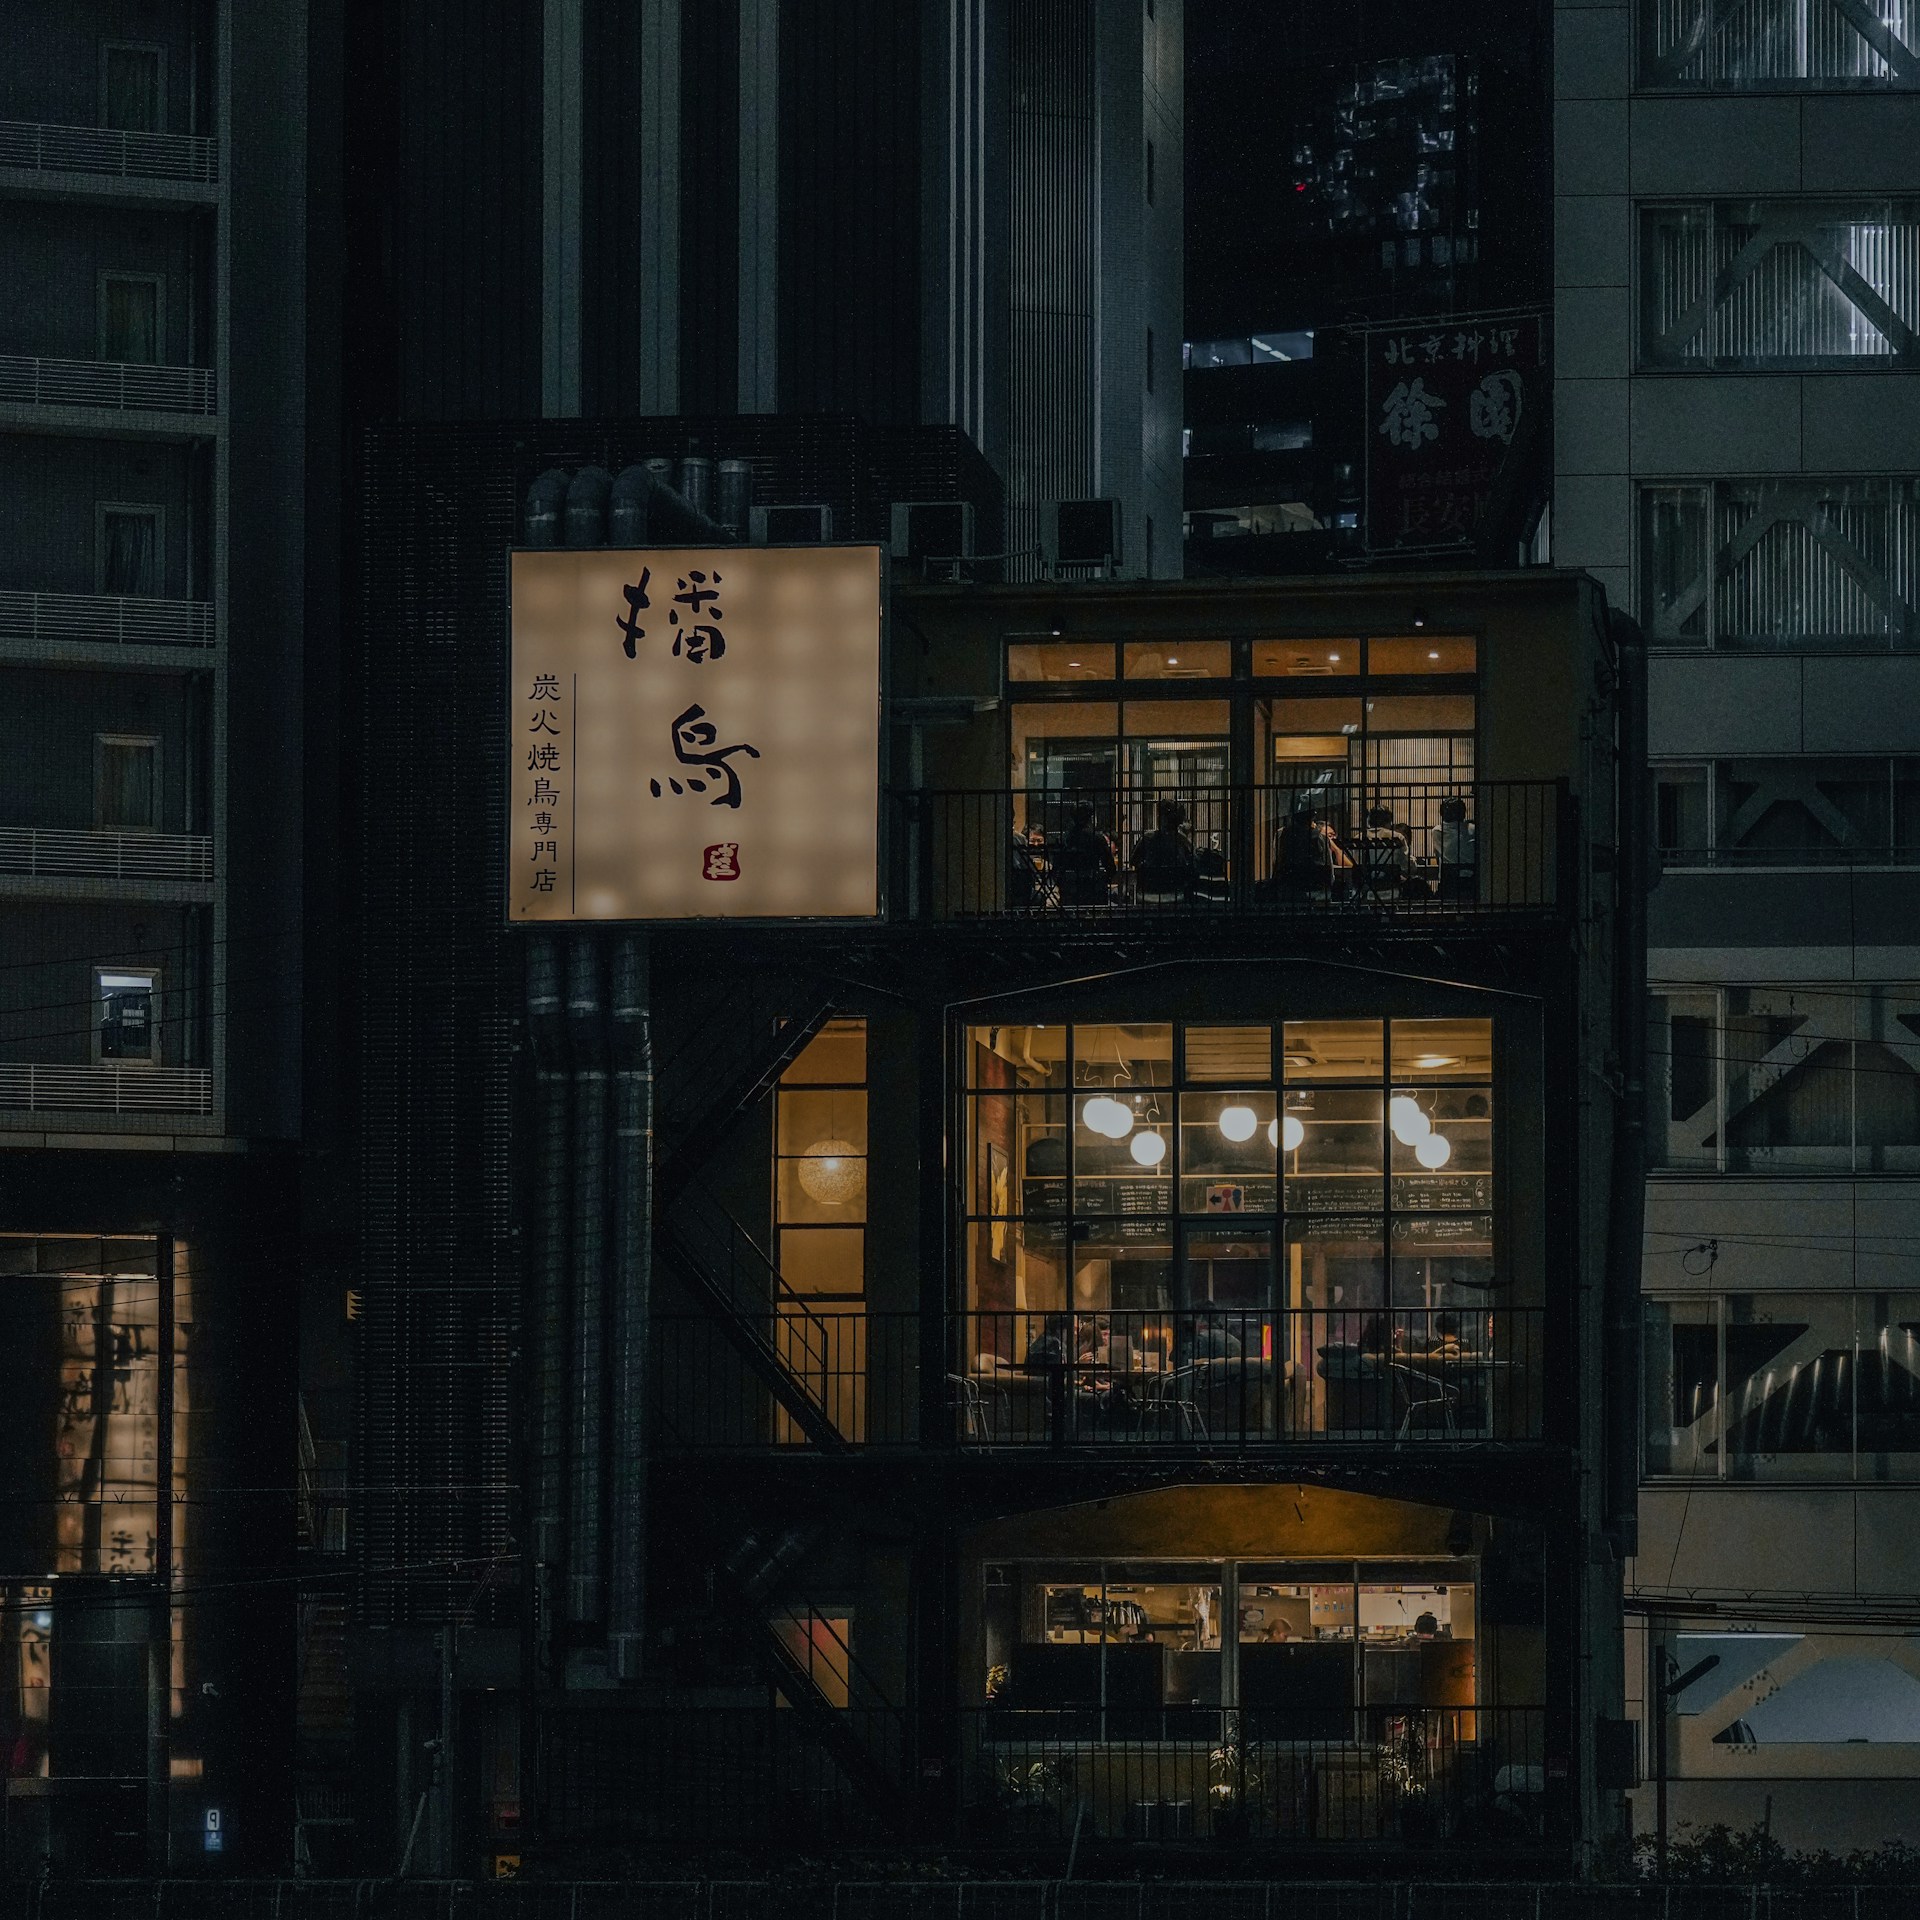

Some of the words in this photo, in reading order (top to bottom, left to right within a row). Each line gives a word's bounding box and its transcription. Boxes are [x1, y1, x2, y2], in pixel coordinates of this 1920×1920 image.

[527, 673, 562, 892] 炭火焼鳥専門店
